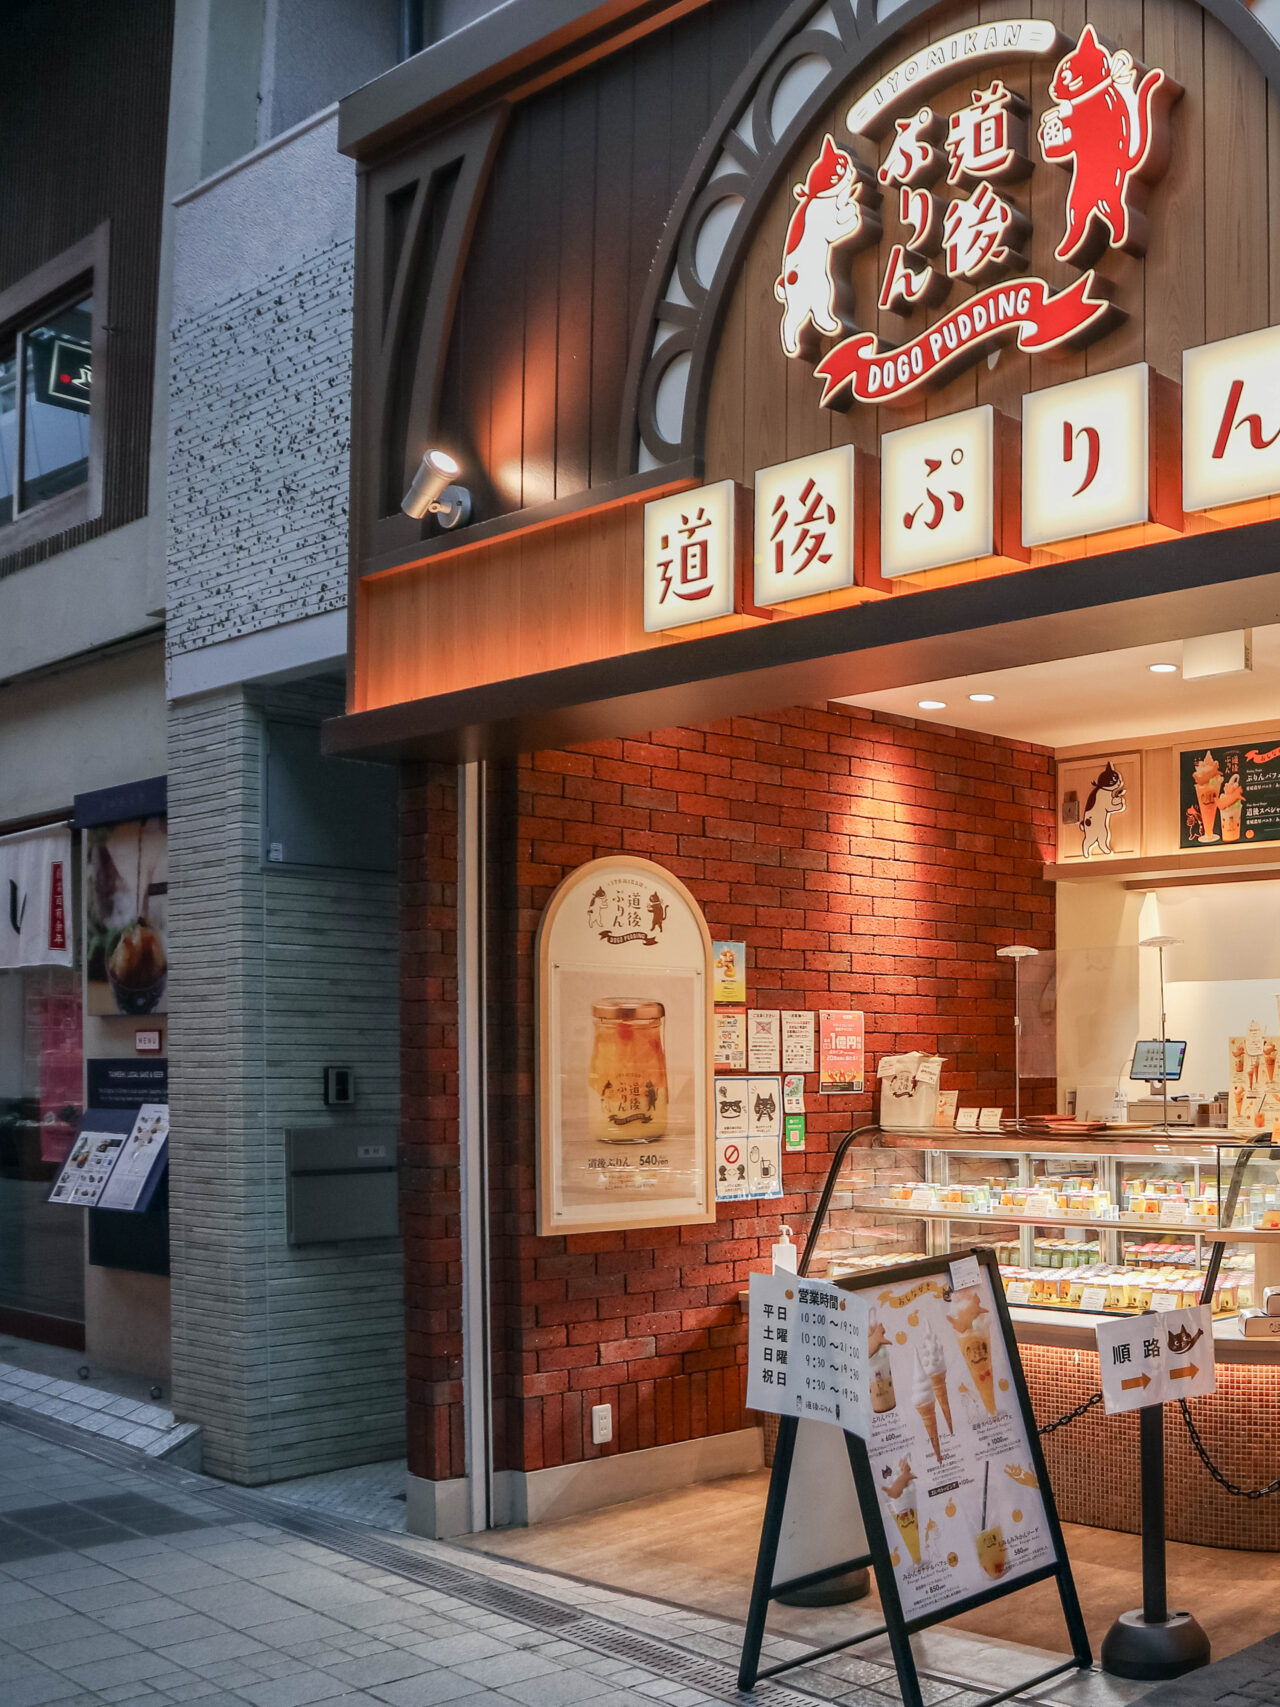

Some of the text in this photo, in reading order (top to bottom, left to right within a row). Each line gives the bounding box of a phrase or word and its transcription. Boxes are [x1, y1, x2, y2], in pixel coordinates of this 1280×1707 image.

[873, 24, 1021, 105] IYOMIKAN
[943, 81, 1014, 277] 道後
[878, 107, 934, 309] ぷりん
[867, 286, 1030, 395] DOGO PUDDING
[627, 892, 641, 928] 道後
[763, 1304, 787, 1321] 平日
[798, 1288, 839, 1311] 営業時間
[763, 1325, 788, 1343] 土曜
[763, 1347, 788, 1365] 日曜
[1112, 1338, 1161, 1365] 順路
[762, 1368, 787, 1387] 祝日
